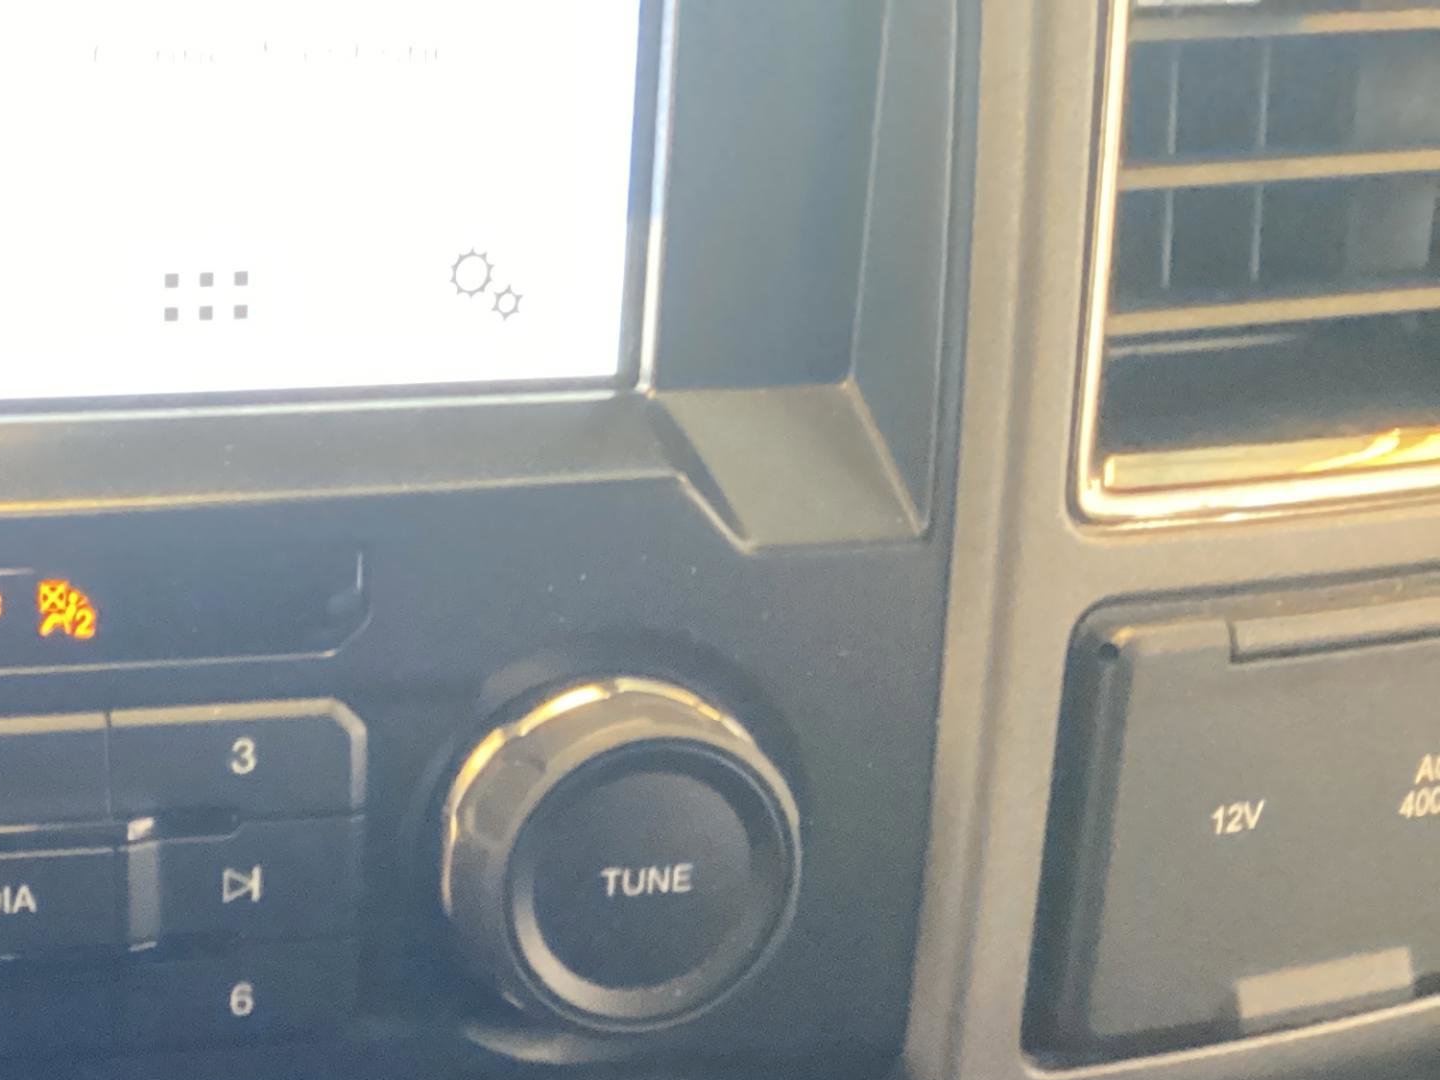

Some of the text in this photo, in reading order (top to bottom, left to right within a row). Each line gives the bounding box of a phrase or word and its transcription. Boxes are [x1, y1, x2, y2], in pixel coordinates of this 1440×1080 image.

[230, 737, 257, 775] 3
[1211, 798, 1266, 835] 12V
[601, 861, 694, 897] TUNE
[228, 981, 256, 1016] 6
